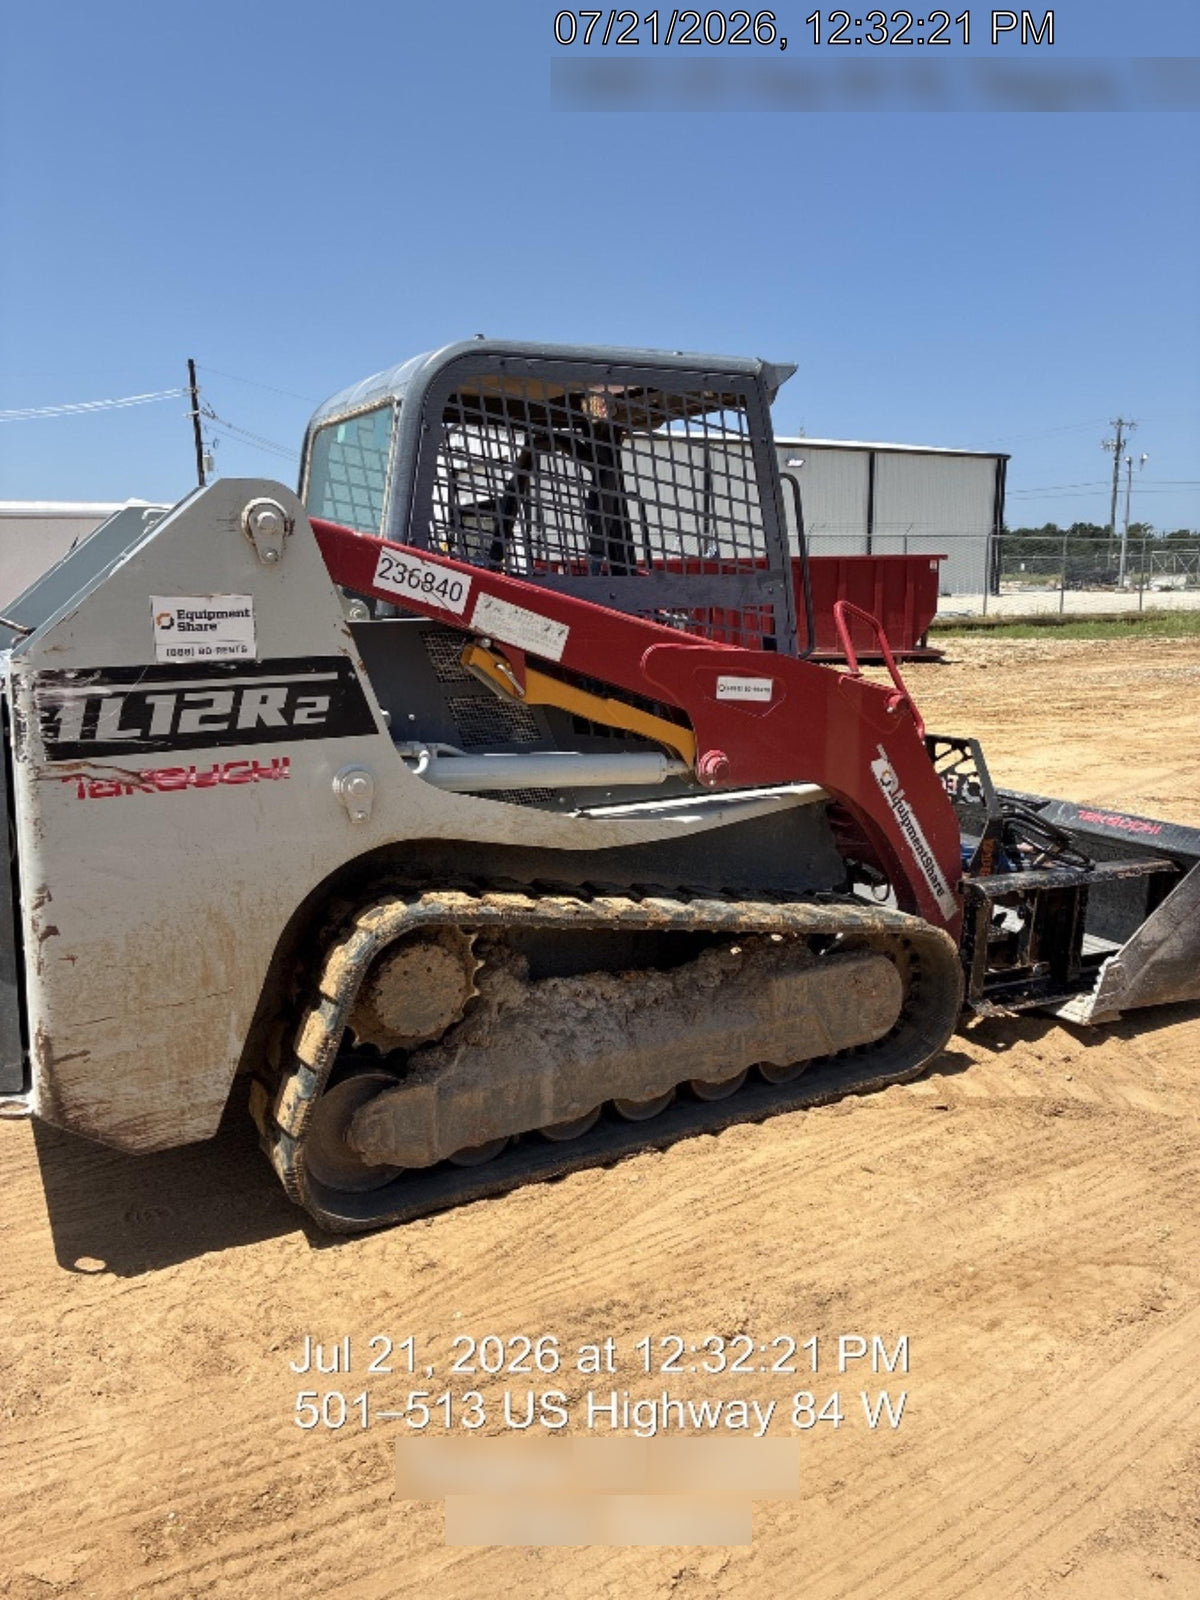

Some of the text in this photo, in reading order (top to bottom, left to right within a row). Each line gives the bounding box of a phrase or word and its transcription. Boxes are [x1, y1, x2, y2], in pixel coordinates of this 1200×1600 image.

[378, 557, 463, 602] 236840
[176, 608, 251, 621] Equipment
[177, 622, 217, 632] Share
[889, 789, 945, 897] quipmentShare
